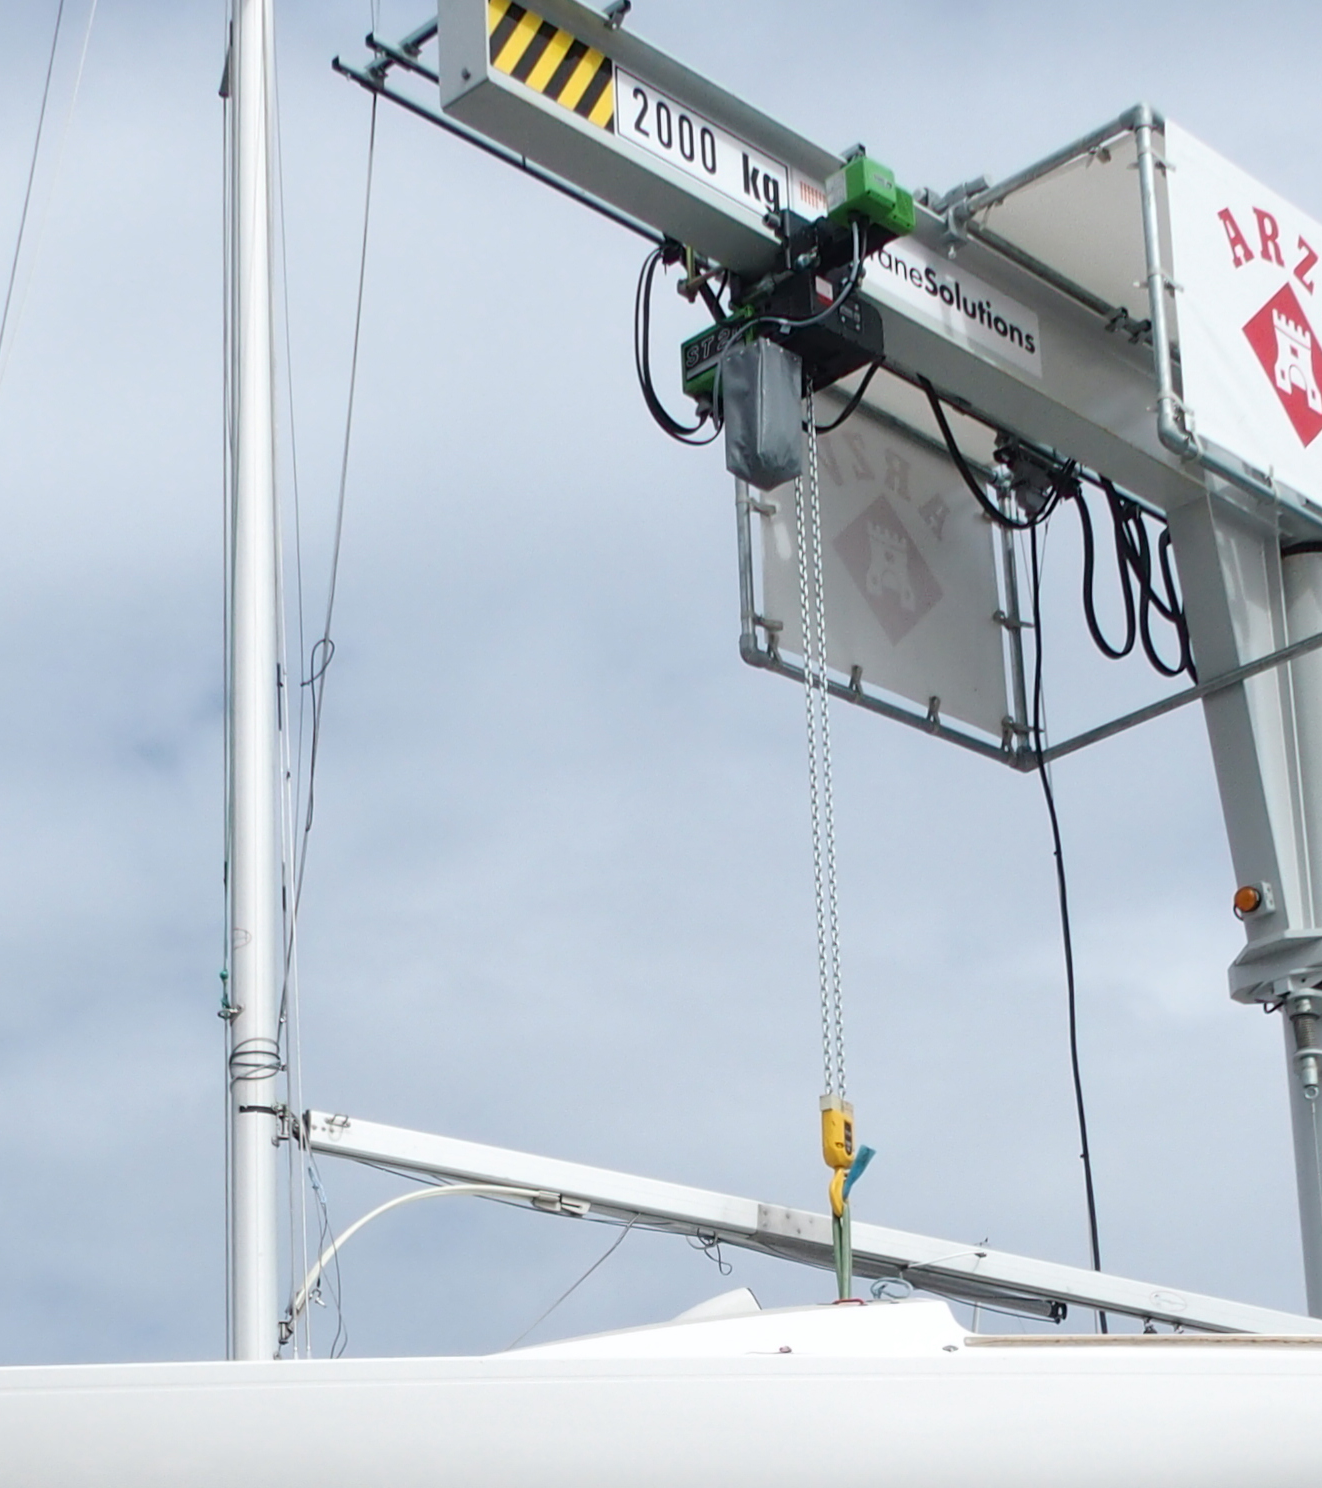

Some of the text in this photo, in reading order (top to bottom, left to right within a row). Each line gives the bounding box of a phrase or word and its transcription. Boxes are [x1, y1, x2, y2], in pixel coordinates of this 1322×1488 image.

[632, 86, 780, 213] 2000 kg
[869, 249, 1036, 354] aneSolutions
